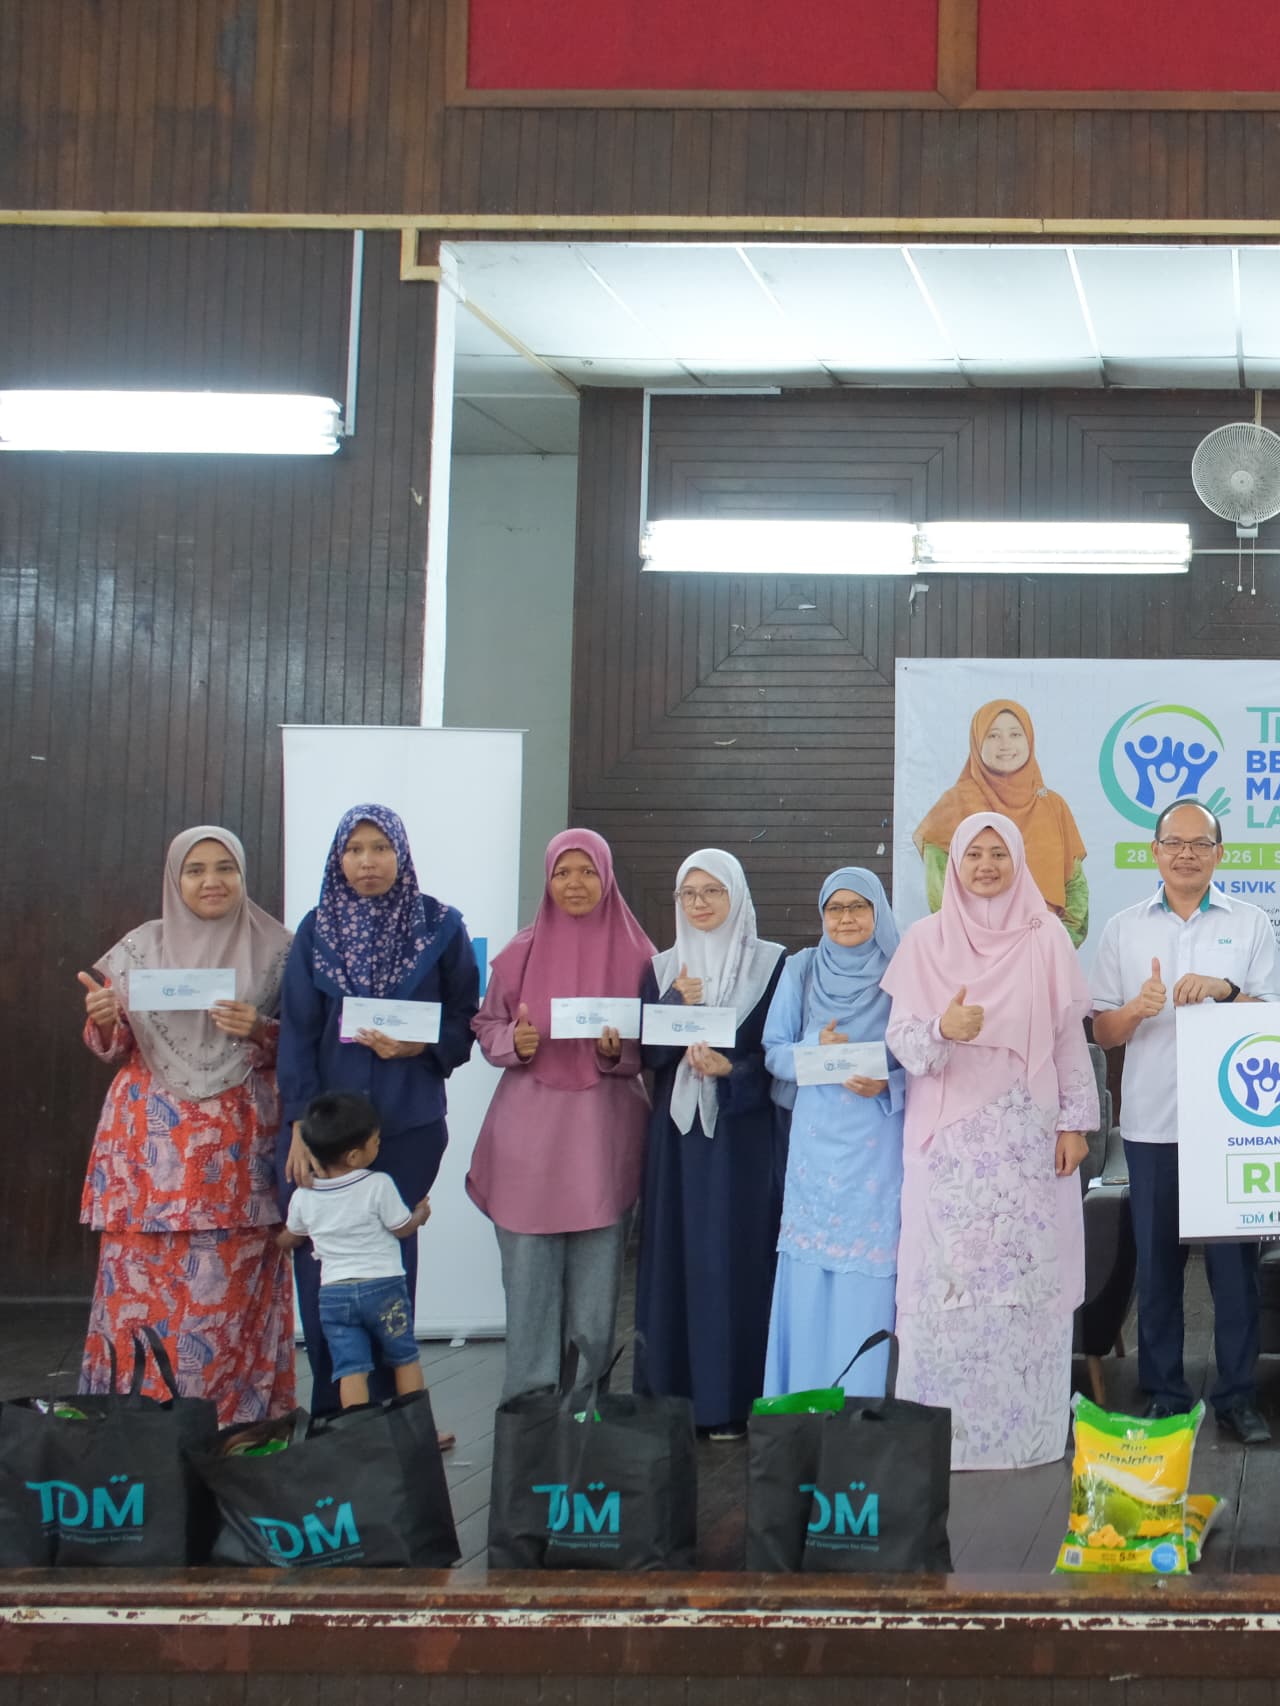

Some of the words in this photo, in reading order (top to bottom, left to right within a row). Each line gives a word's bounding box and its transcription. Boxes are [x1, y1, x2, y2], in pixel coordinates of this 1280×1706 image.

[1127, 850, 1147, 863] 28
[1221, 850, 1252, 864] 026
[1231, 881, 1276, 894] SIVIK
[1240, 1211, 1265, 1224] TDM
[25, 1474, 144, 1529] TDM
